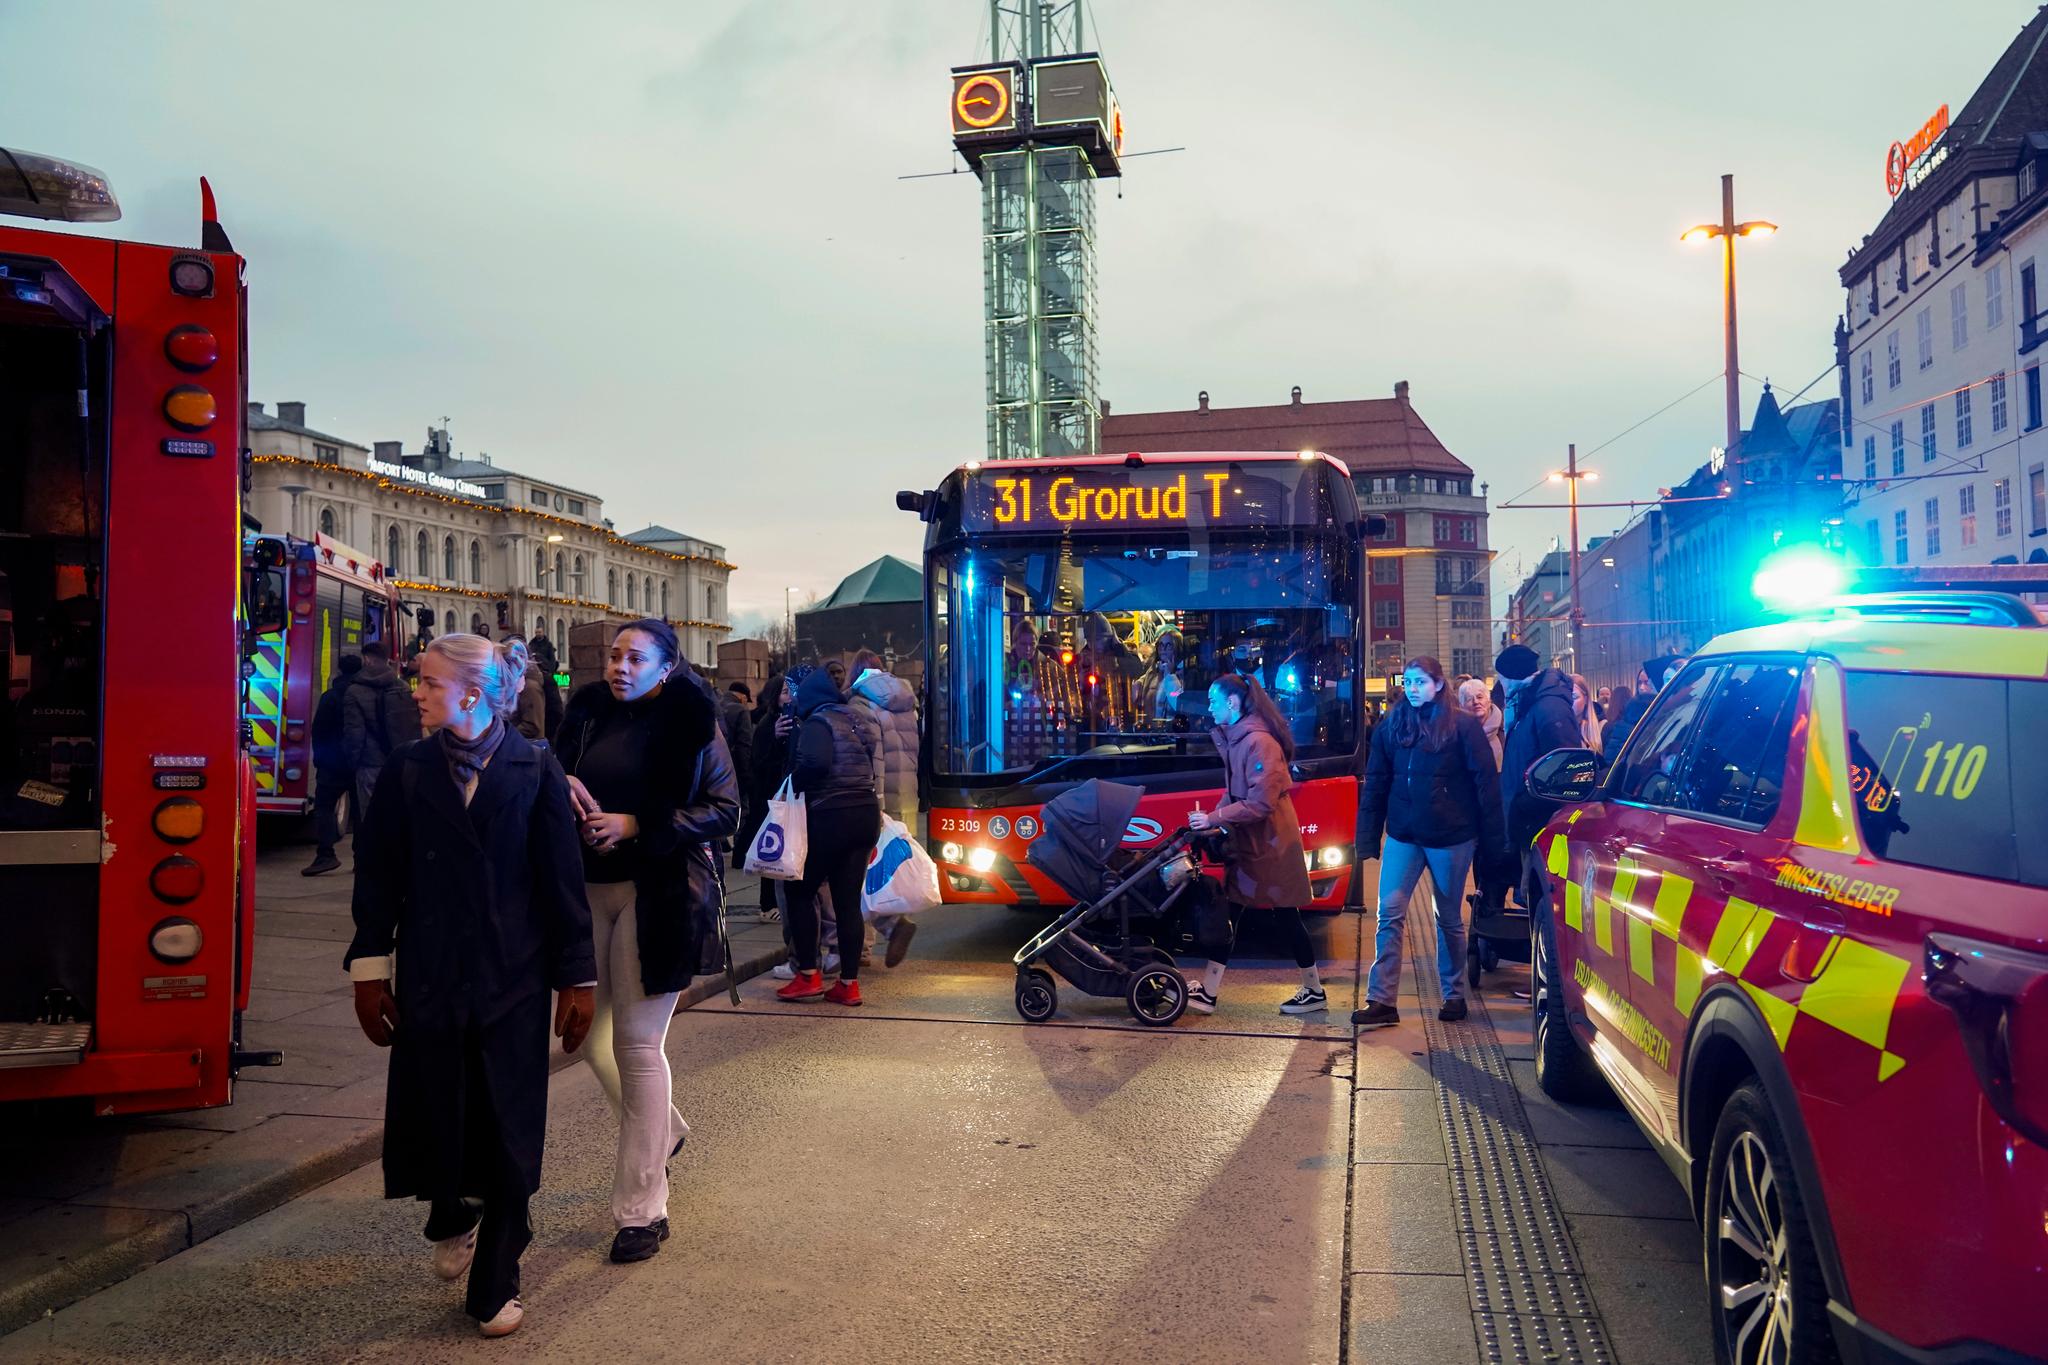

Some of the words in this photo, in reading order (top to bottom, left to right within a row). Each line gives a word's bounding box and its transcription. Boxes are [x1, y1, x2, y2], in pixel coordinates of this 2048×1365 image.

[366, 459, 401, 477] OMFORT
[995, 478, 1030, 522] 31
[1049, 474, 1186, 521] Grorud
[1204, 473, 1229, 518] T
[1915, 741, 1988, 800] 110
[941, 818, 955, 831] 23
[958, 820, 981, 833] 309
[1298, 823, 1318, 835] r#
[1775, 862, 1900, 917] INNSATSLEDER
